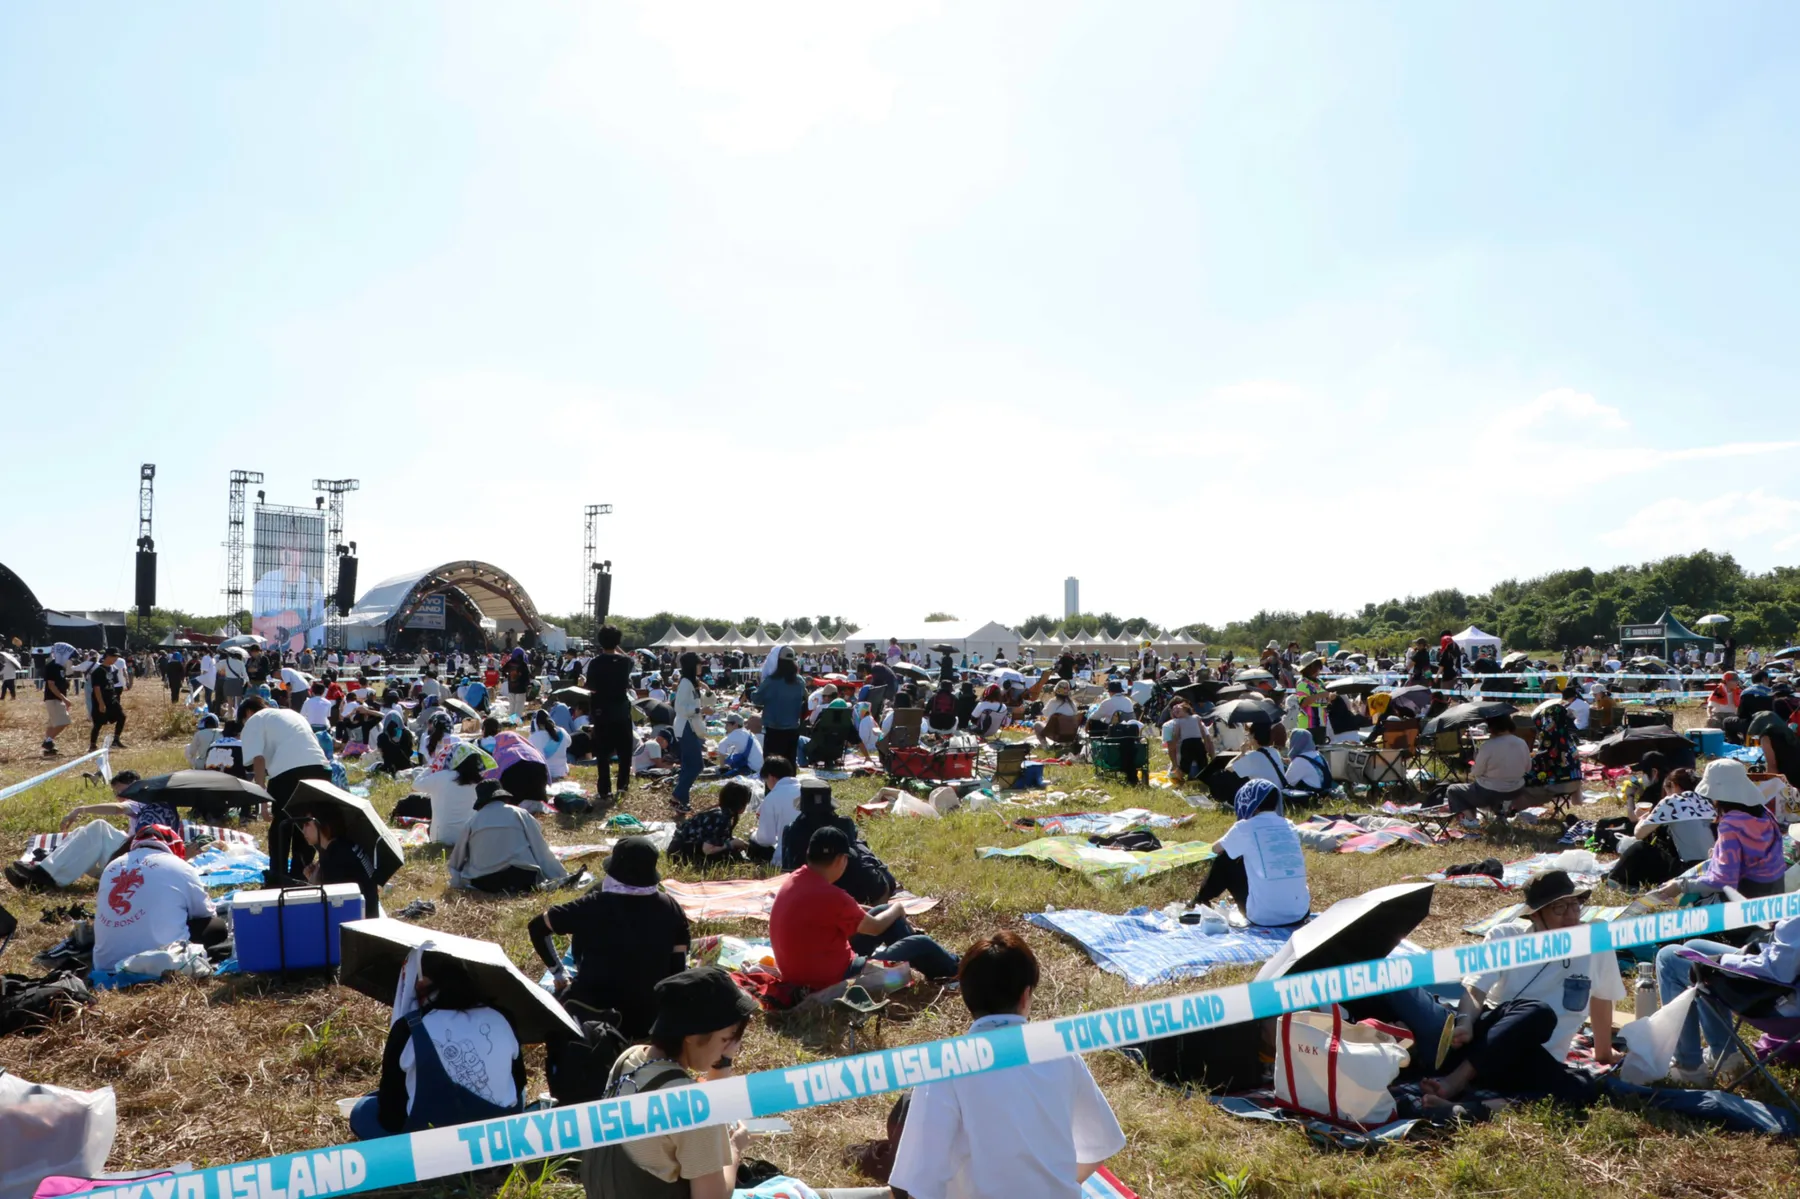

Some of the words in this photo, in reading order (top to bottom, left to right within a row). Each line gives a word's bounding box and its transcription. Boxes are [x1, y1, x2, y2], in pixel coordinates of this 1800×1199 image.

[132, 858, 160, 870] ARE
[99, 913, 111, 928] THE
[113, 908, 147, 929] BONEZ
[1607, 915, 1656, 948] TOKYO
[1659, 908, 1709, 939] ISLAND
[1740, 895, 1782, 925] TOKYO
[1785, 893, 1800, 917] IS
[1455, 940, 1511, 974] TOKYO
[1515, 931, 1571, 964] ISLAND
[1273, 969, 1341, 1010] TOKYO
[1344, 959, 1413, 997] ISLAND
[1054, 1008, 1140, 1053] TOKYO
[1142, 994, 1225, 1037] ISLAND
[784, 1054, 889, 1105] TOKYO
[892, 1037, 995, 1086] ISLAND
[458, 1109, 581, 1166] TOKYO
[588, 1089, 711, 1143] ISLAND
[217, 1149, 367, 1199] ISLAND
